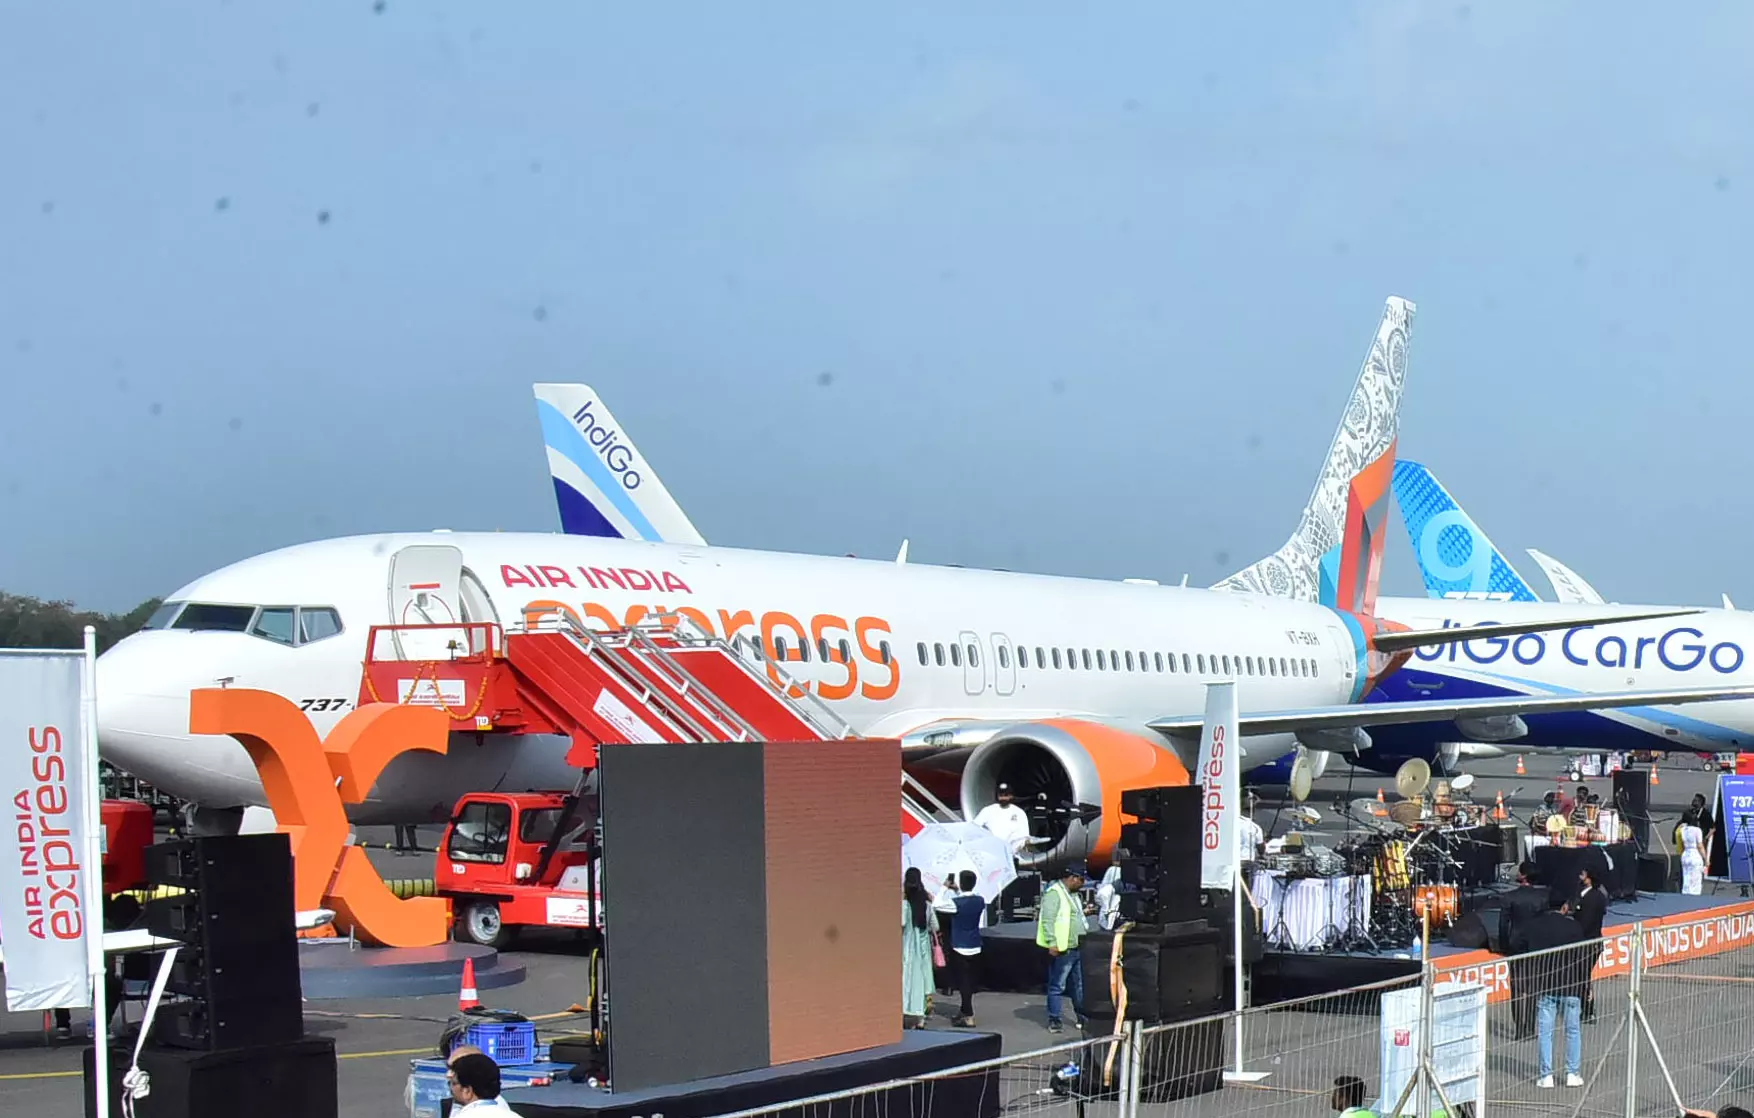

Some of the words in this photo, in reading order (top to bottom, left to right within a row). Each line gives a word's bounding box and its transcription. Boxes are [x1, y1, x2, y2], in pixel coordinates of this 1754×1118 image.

[573, 401, 640, 489] IndiGo
[500, 564, 576, 589] AIR
[578, 566, 693, 594] INDIA
[1561, 626, 1744, 673] CarGo
[1204, 725, 1225, 850] express
[14, 789, 39, 876] INDIA
[29, 725, 82, 940] express
[25, 886, 46, 939] AIR
[1692, 922, 1715, 949] OF
